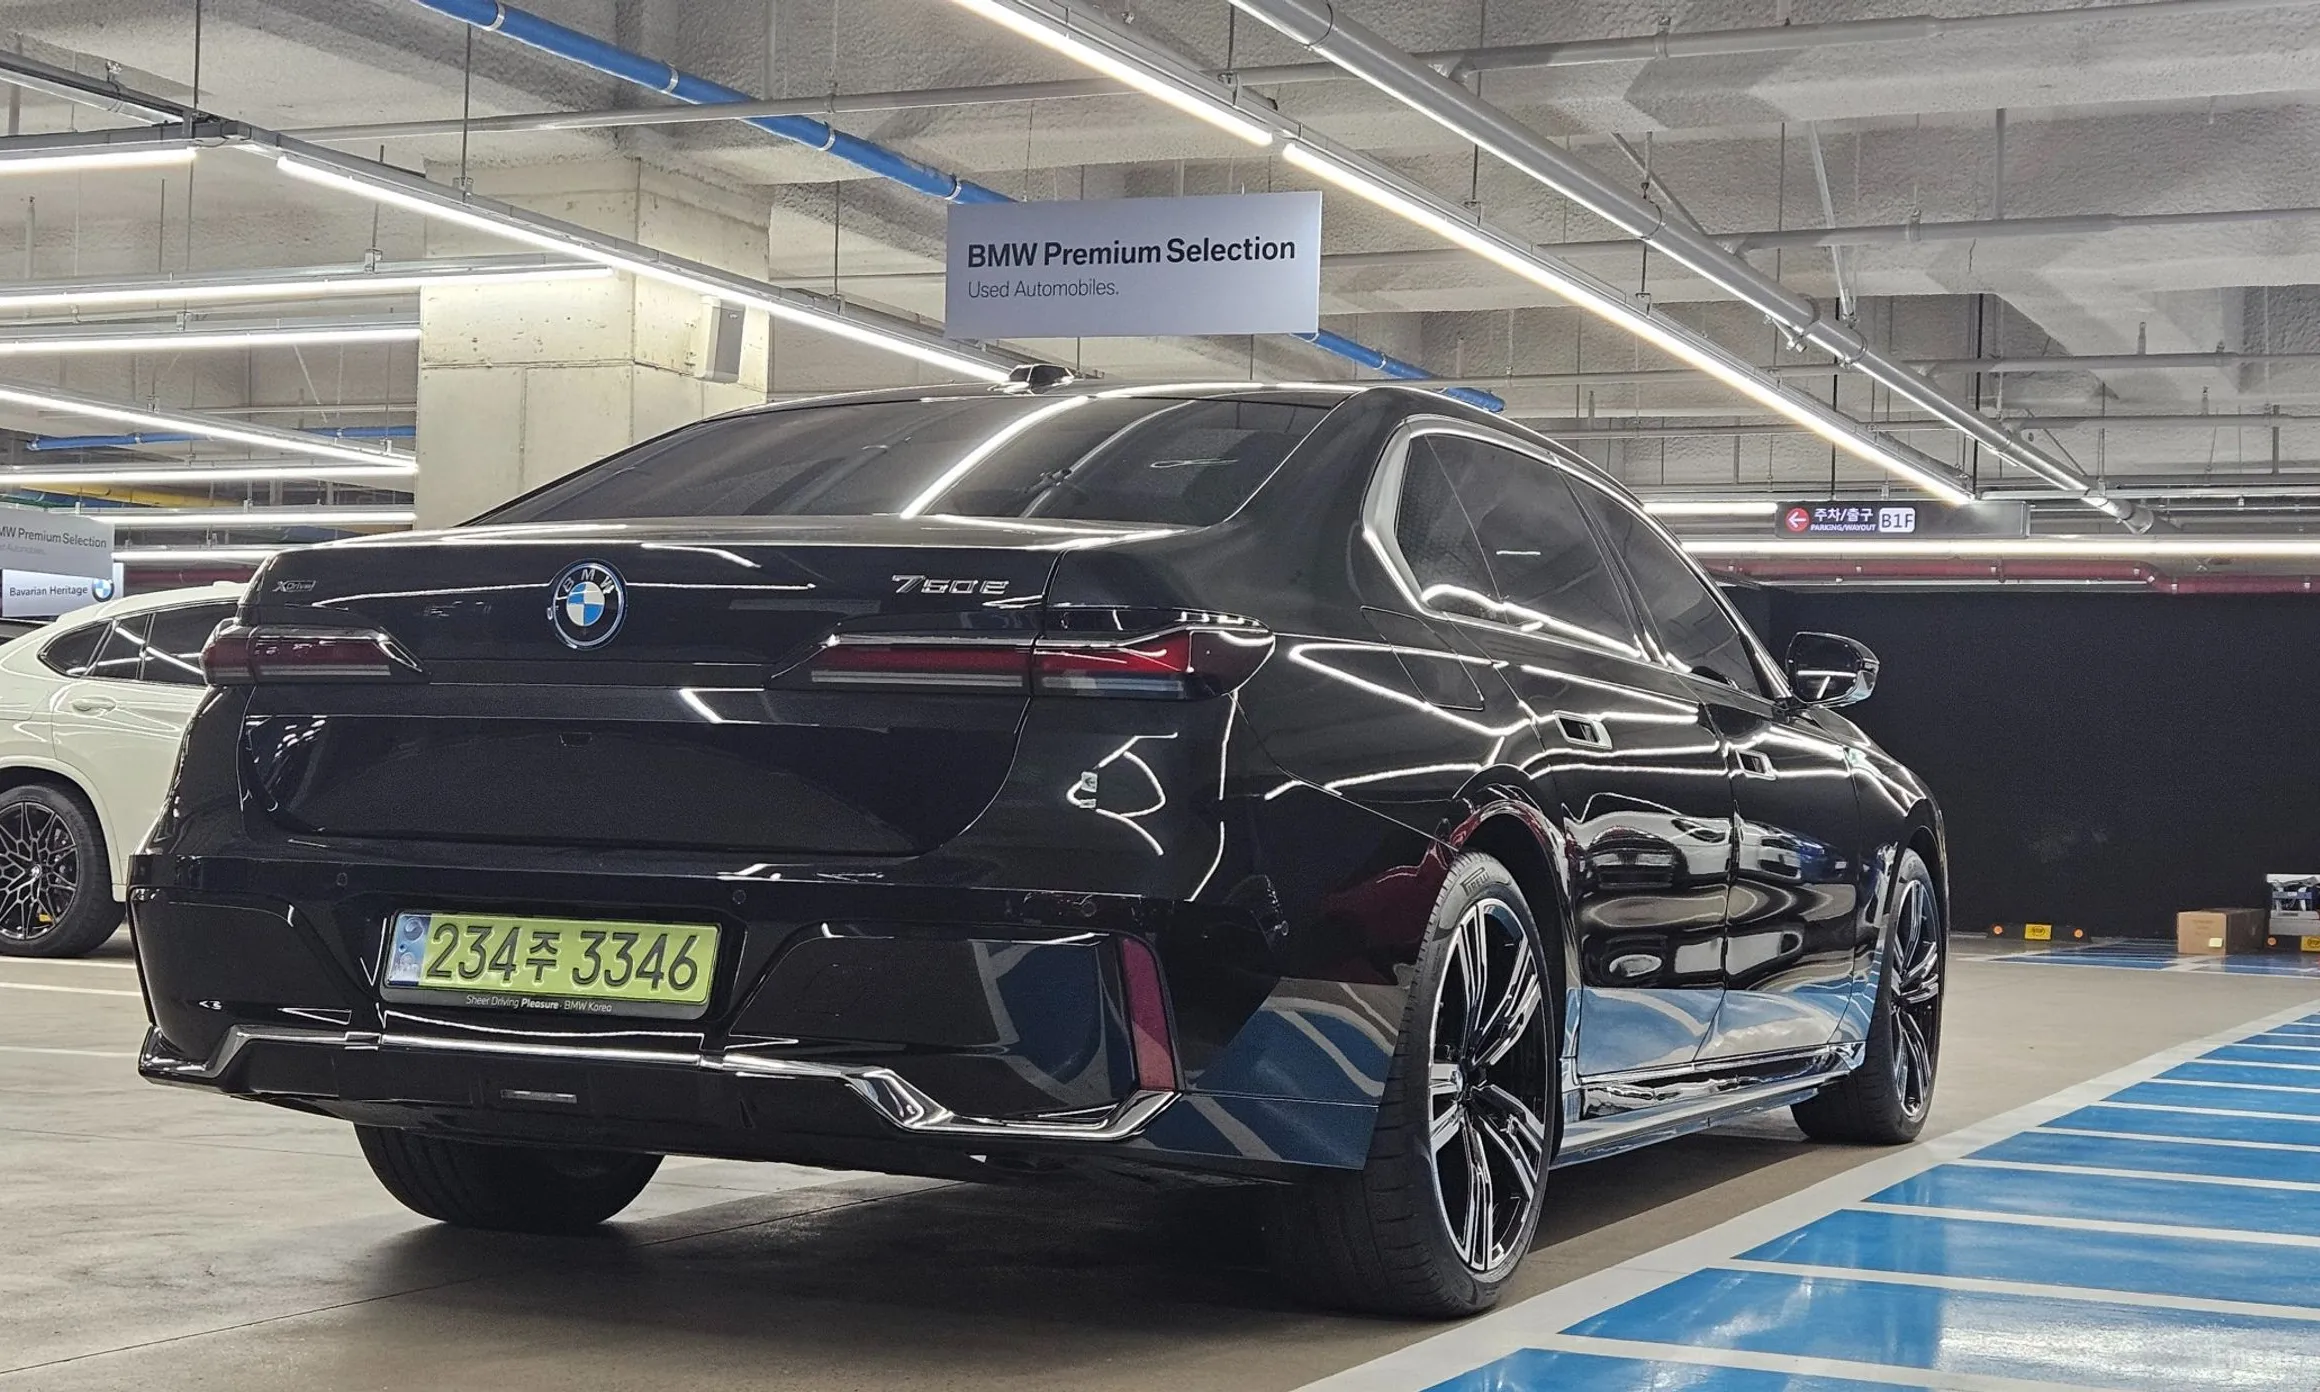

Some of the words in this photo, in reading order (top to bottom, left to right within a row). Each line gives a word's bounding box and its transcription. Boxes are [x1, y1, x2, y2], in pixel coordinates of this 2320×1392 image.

[968, 242, 1038, 268] BMW
[1044, 240, 1161, 266] Premium
[1166, 236, 1296, 263] Selection
[968, 280, 1009, 299] Used
[1014, 278, 1120, 298] Automobiles.
[1814, 508, 1874, 522] 주차/출구
[1881, 513, 1914, 528] B1F
[18, 527, 61, 543] Premium
[62, 532, 107, 548] Selection
[9, 587, 47, 597] Bavarian
[49, 586, 88, 596] Heritage
[563, 568, 614, 594] BMW
[427, 923, 560, 983] 234주
[571, 931, 700, 992] 3346
[466, 994, 490, 1005] Sheer
[491, 997, 519, 1009] Driving
[521, 998, 560, 1010] Pleasure
[564, 1000, 587, 1011] BMW
[588, 1002, 613, 1013] Korea
